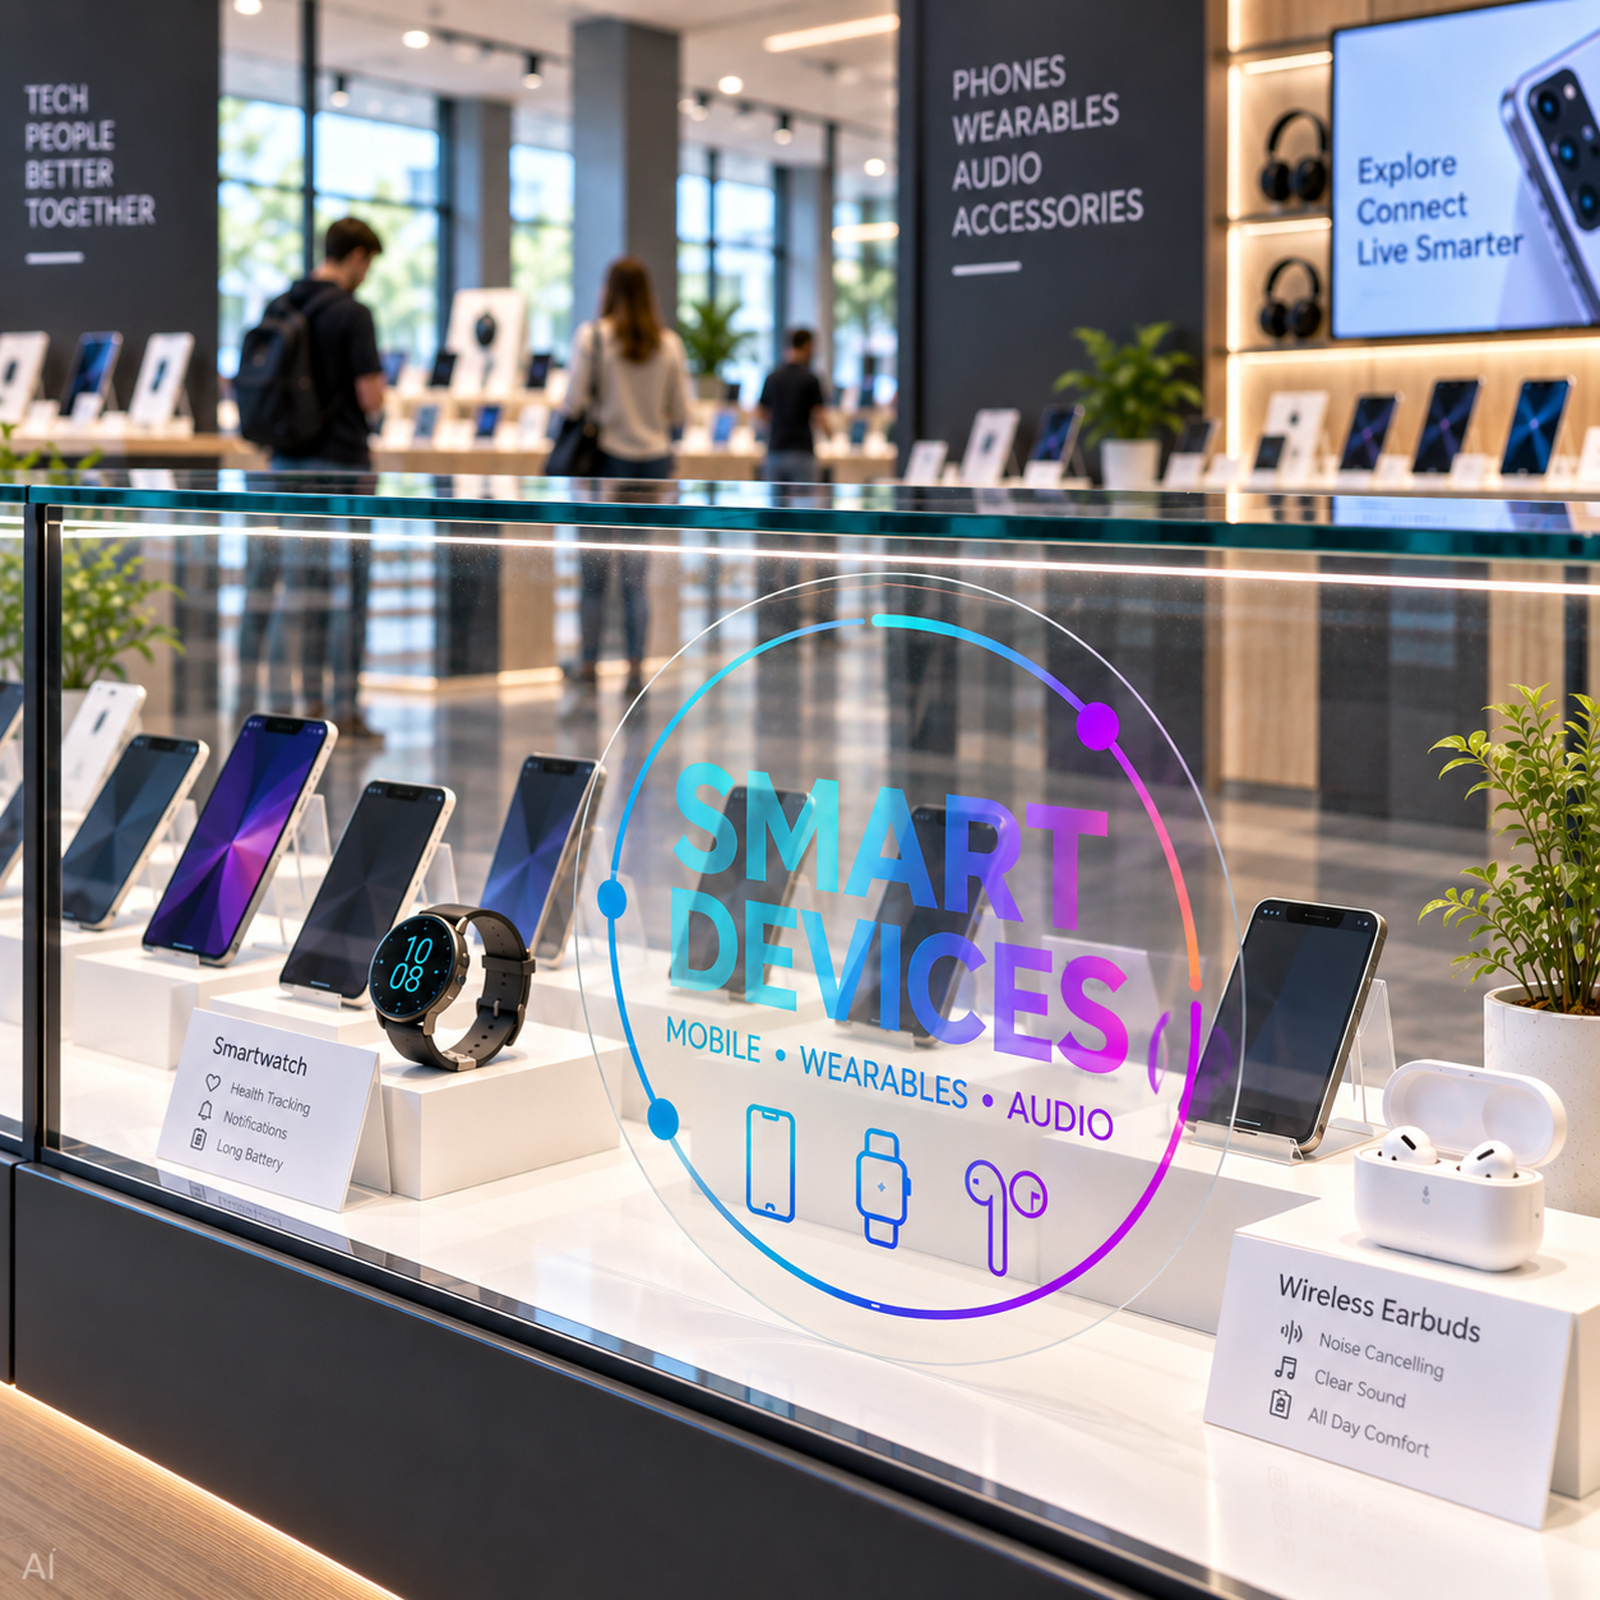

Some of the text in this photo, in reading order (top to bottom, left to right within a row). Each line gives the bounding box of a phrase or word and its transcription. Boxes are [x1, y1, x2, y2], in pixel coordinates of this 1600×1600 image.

[953, 54, 1066, 101] PHONES
[24, 83, 88, 115] TECH
[25, 119, 116, 152] PEOPLE
[952, 92, 1120, 145] WEARABLES
[25, 157, 114, 190] BETTER
[952, 151, 1042, 191] AUDIO
[1358, 151, 1457, 188] Explore
[24, 194, 156, 229] TOGETHER
[952, 187, 1144, 238] ACCESSORIES
[1357, 191, 1468, 225] Connect
[1358, 231, 1524, 266] Live Smarter
[673, 762, 1108, 931] SMART
[405, 935, 434, 964] 10
[389, 962, 423, 992] 08
[670, 887, 1129, 1074] DEVICES
[212, 1036, 308, 1076] Smartwatch
[666, 1016, 1114, 1141] MOBILE WEARABLES AUDIO
[230, 1082, 311, 1118] Health Tracking
[223, 1110, 288, 1140] Notifications
[216, 1139, 284, 1174] Long Battery
[1279, 1273, 1481, 1342] Wireless Earbuds
[1319, 1332, 1445, 1382] Noise Cancelling
[1314, 1369, 1406, 1409] Clear Sound
[1307, 1407, 1430, 1458] All Day Comfort
